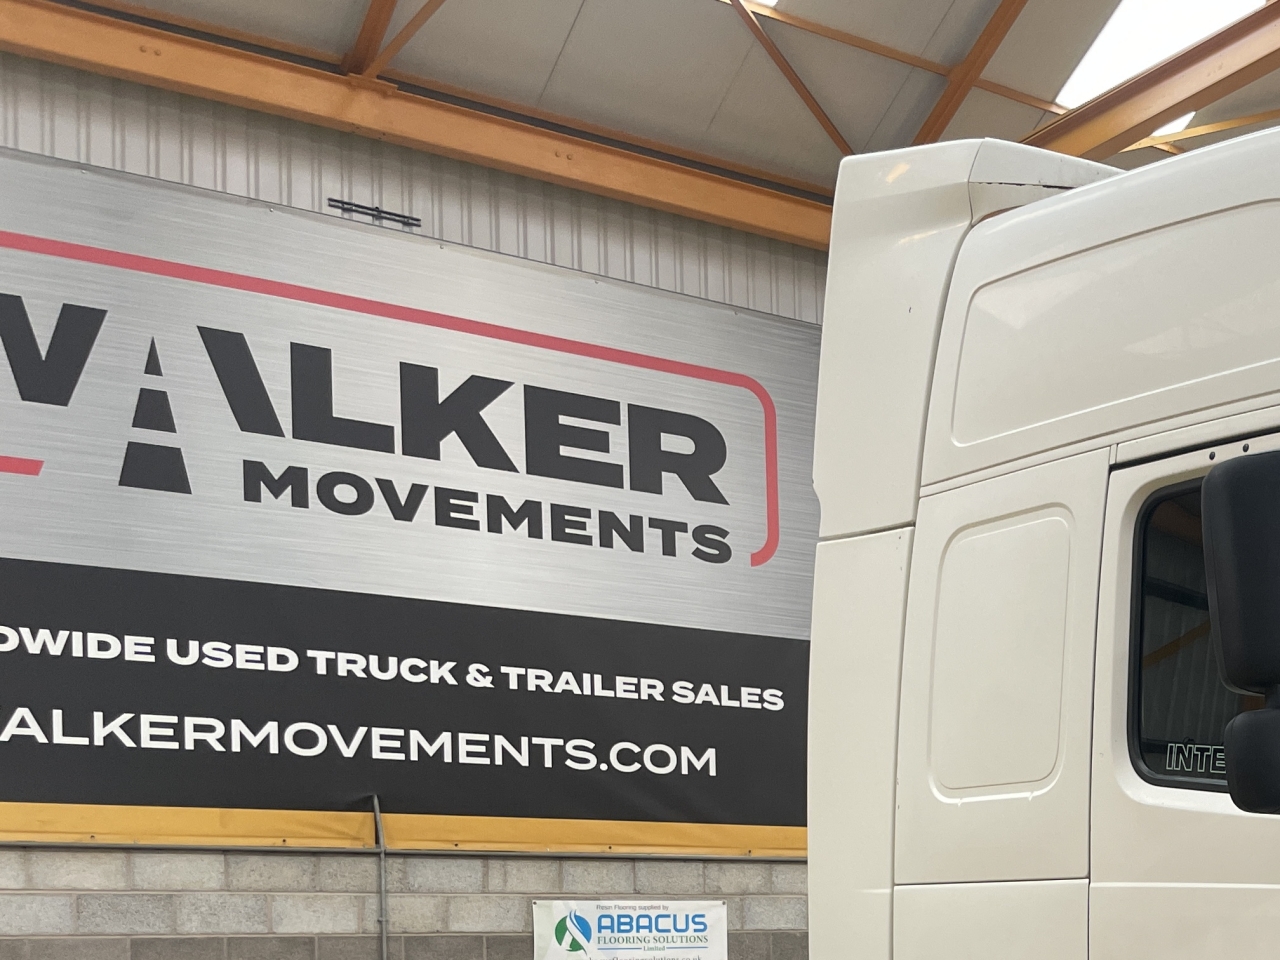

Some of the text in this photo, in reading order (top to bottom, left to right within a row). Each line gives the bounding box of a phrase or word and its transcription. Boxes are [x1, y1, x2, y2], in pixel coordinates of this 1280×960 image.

[243, 459, 732, 564] MOVEMENTS
[166, 638, 299, 672] USED
[307, 649, 458, 686] TRUCK
[466, 663, 495, 688] &
[500, 665, 664, 702] TRAILER
[671, 680, 785, 711] SALES
[0, 707, 717, 777] ALKERMOVEMENTS.COM
[597, 913, 708, 934] ABACUS
[614, 904, 637, 912] Flooring
[638, 904, 661, 912] supplied
[597, 934, 709, 945] FLOORING SOLUTIONS
